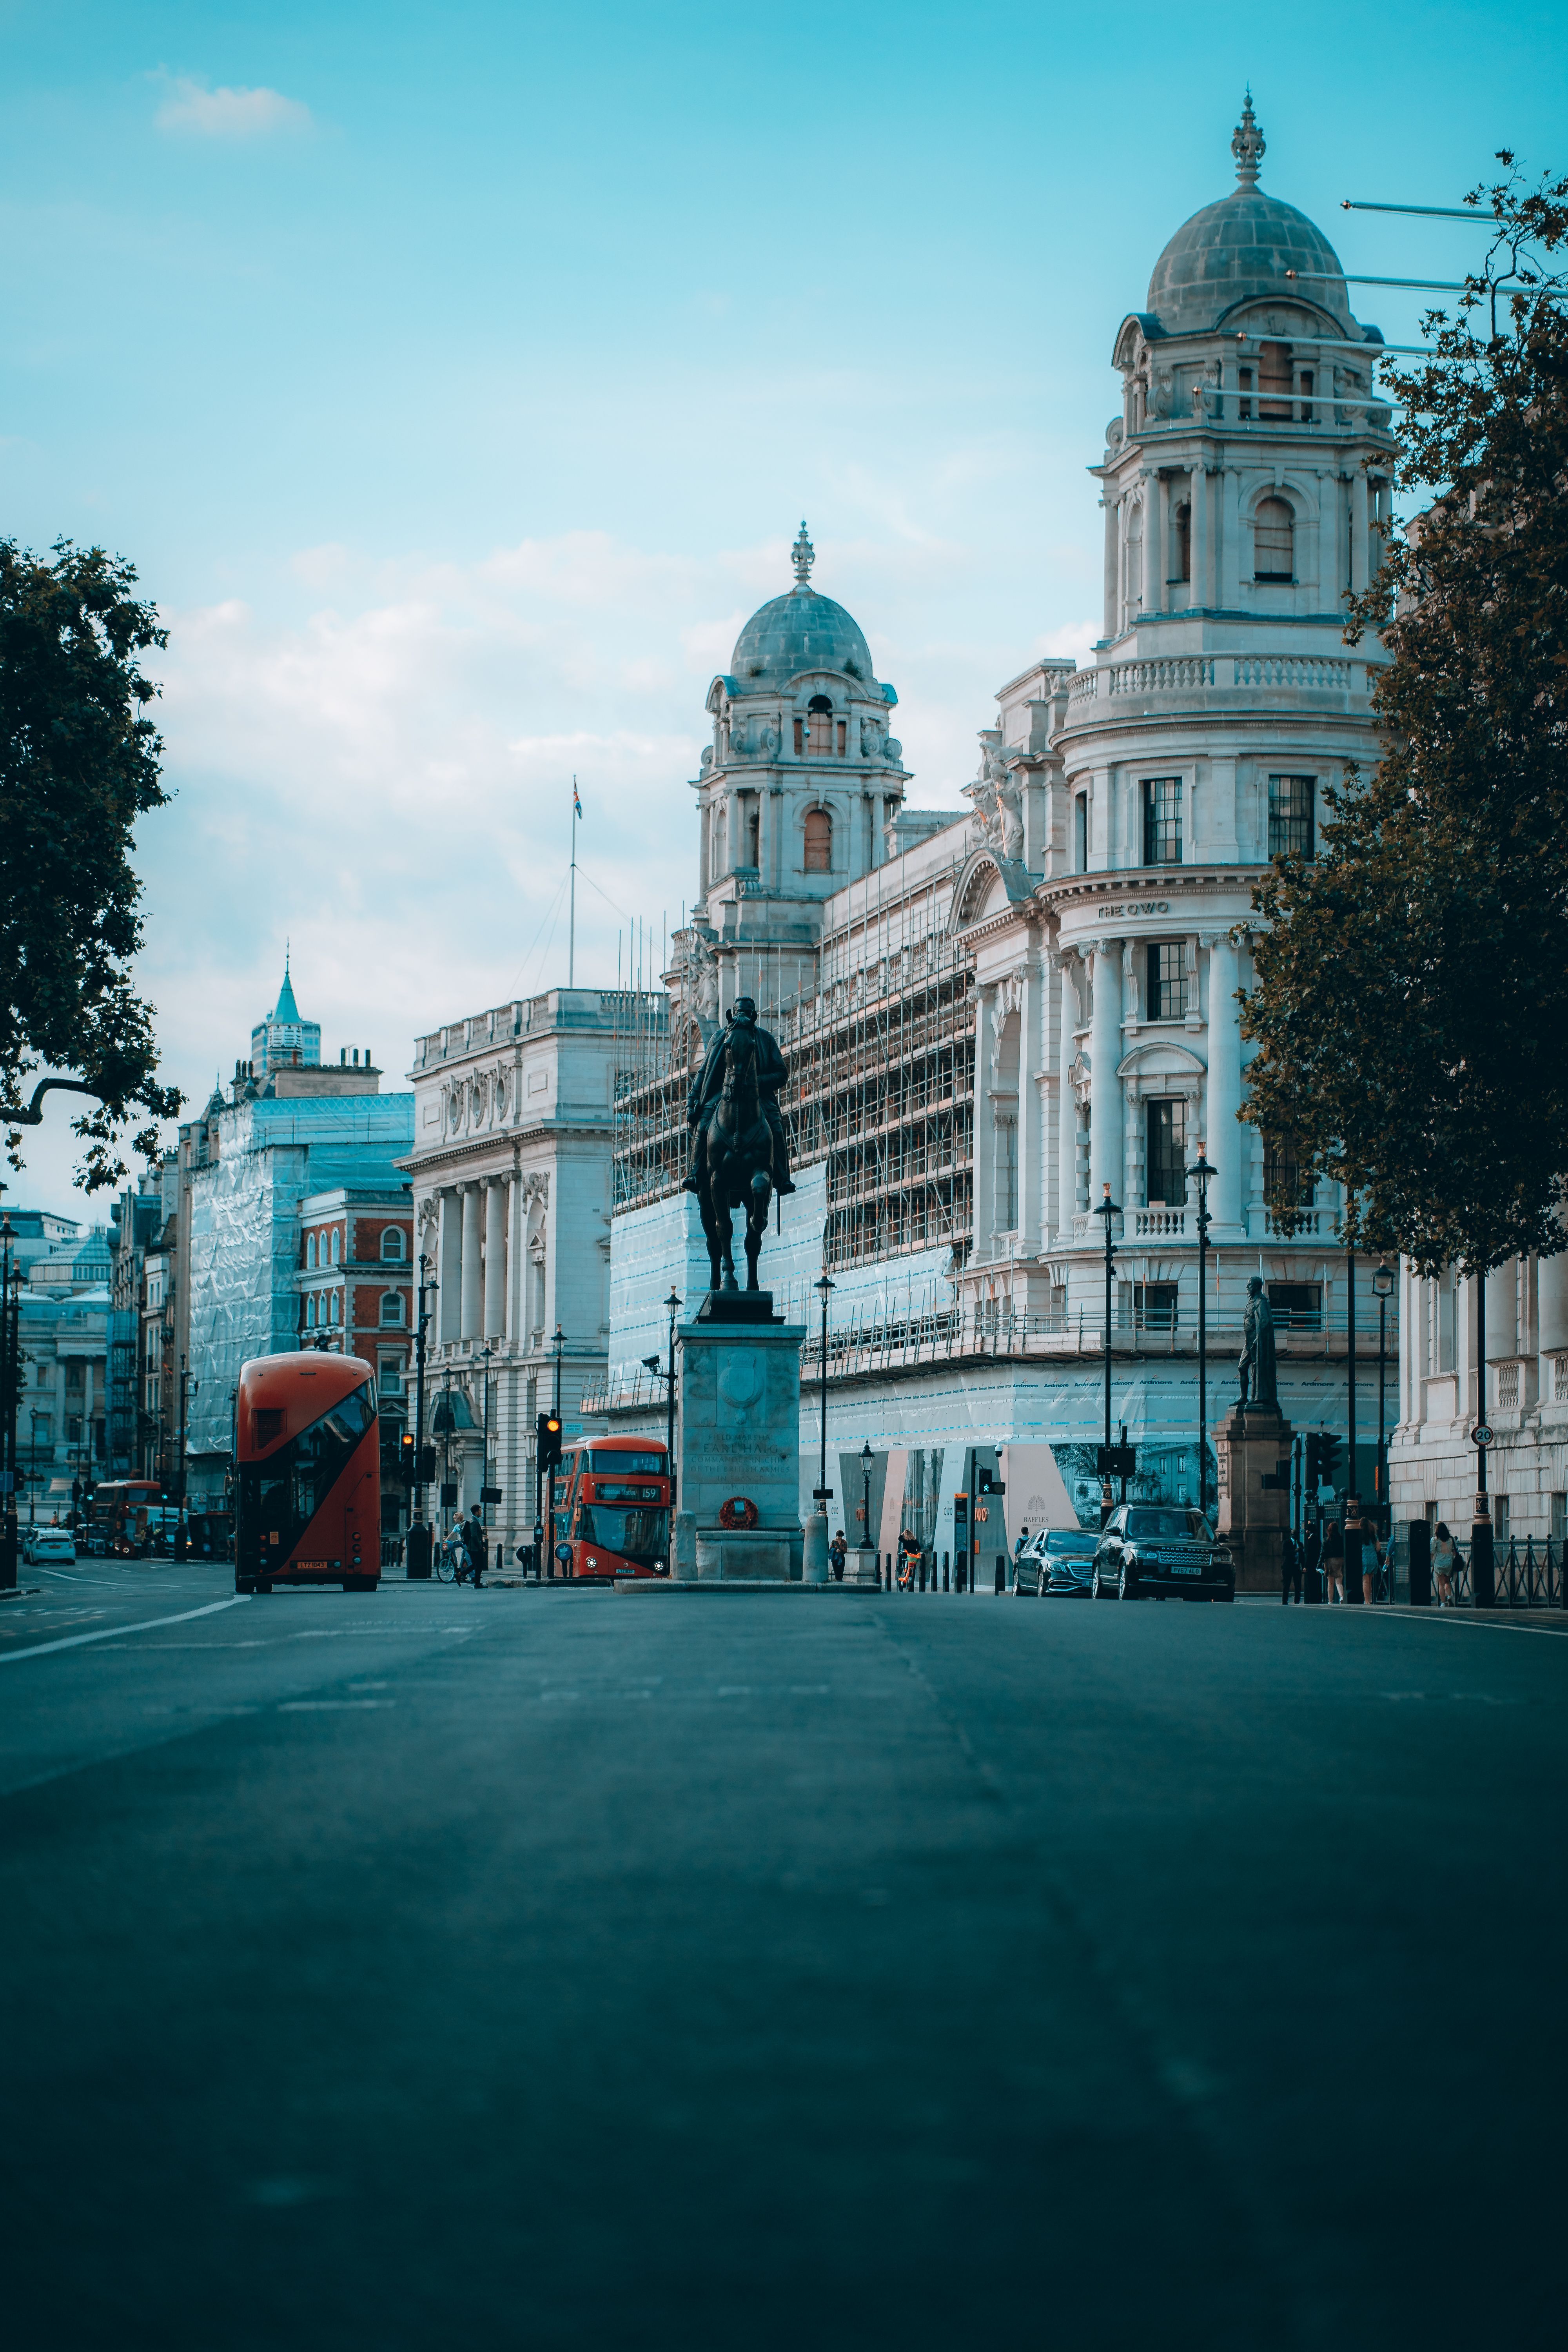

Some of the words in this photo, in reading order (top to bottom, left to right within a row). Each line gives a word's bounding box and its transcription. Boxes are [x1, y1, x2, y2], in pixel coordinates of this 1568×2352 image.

[1096, 906, 1123, 919] THE
[1127, 902, 1168, 915] OWO
[1477, 1431, 1491, 1439] 20
[704, 1444, 737, 1453] EARL
[743, 1444, 778, 1454] HAIG
[643, 1488, 656, 1498] 159
